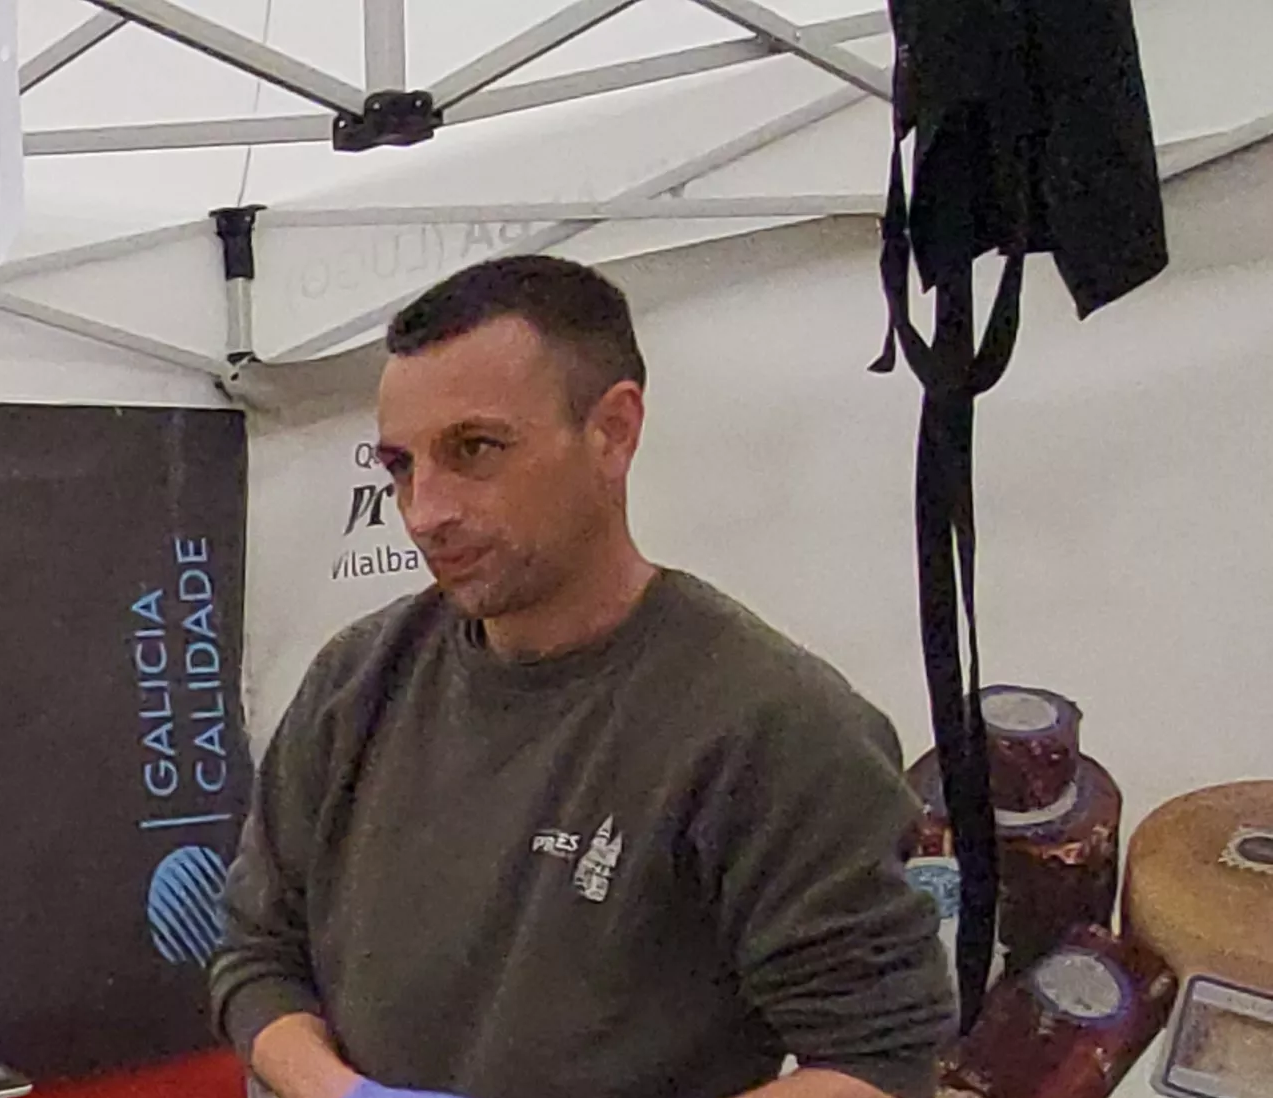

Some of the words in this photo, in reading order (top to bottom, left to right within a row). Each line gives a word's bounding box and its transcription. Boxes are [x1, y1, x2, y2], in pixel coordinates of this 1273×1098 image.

[175, 536, 228, 793] CALIDADE
[332, 544, 419, 580] Vilalba
[131, 588, 179, 797] GALICIA
